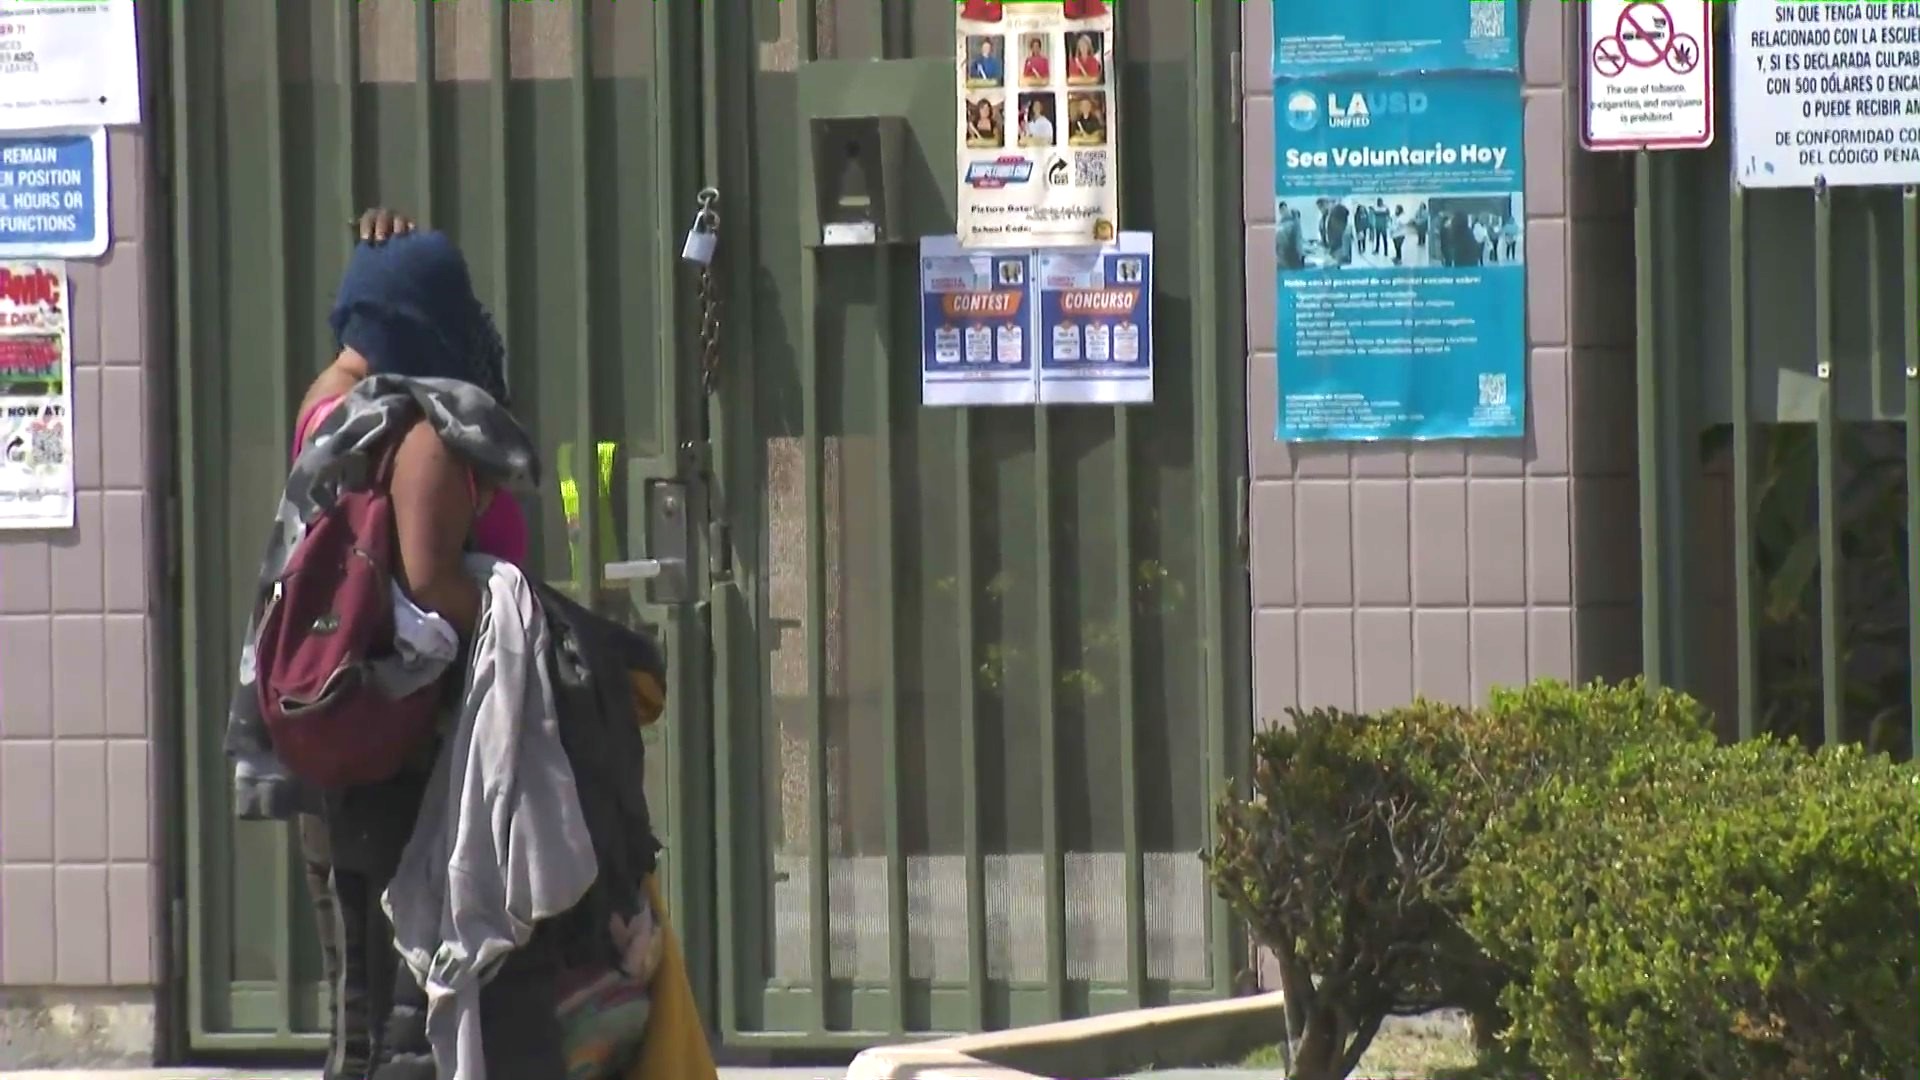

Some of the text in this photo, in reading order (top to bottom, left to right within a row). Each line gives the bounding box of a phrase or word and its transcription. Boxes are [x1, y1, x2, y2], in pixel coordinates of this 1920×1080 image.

[1776, 6, 1794, 22] SIN
[1798, 5, 1820, 22] QUE
[1825, 4, 1862, 21] TENGA
[1866, 3, 1887, 20] QUE
[1751, 29, 1830, 47] RELACIONADO
[1834, 28, 1857, 45] CON
[1862, 28, 1877, 44] LA
[1770, 53, 1781, 70] SI
[1785, 52, 1800, 70] ES
[1804, 51, 1871, 70] DECLARADA
[1875, 50, 1920, 68] CULPAB
[1767, 72, 1920, 95] CON 500 DÓLARES O ENCA
[1803, 101, 1811, 118] O
[1815, 100, 1850, 117] PUEDE
[1856, 99, 1900, 116] RECIBIR
[1328, 117, 1370, 128] UNIFIED
[1775, 131, 1791, 146] DE
[1796, 128, 1894, 146] CONFORMIDAD
[3, 147, 57, 164] REMAIN
[1286, 142, 1507, 169] Sea Voluntario Hoy
[1799, 145, 1920, 165] DEL CÓDIGO PENA
[18, 169, 81, 187] POSITION
[13, 191, 60, 209] HOURS
[64, 190, 83, 209] OR
[0, 214, 76, 232] FUNCTIONS
[953, 293, 1010, 312] CONTEST
[1065, 291, 1133, 309] CONCURSO
[8, 405, 39, 416] NOW
